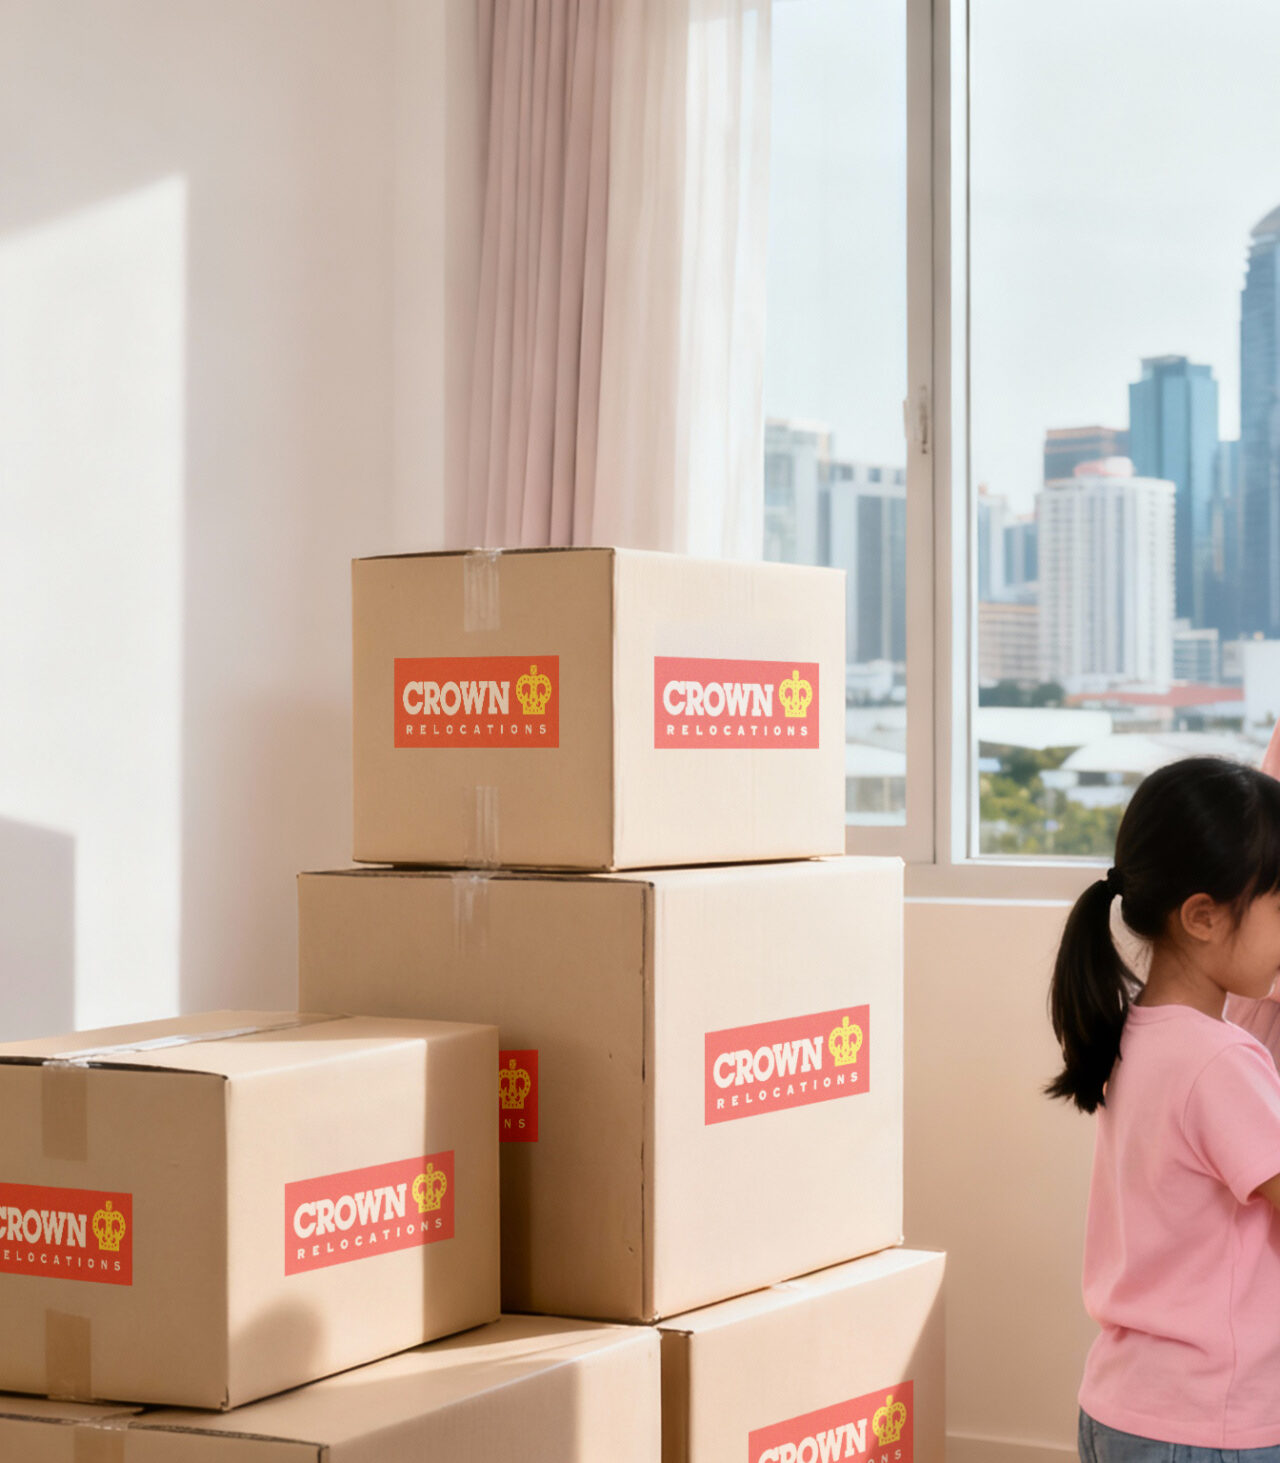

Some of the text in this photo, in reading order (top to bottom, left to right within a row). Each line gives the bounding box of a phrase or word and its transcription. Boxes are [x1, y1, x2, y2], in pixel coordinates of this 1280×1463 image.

[403, 681, 510, 716] CROWN
[663, 680, 774, 717] CROWN
[406, 724, 546, 735] RELOCATIONS
[667, 724, 808, 736] RELOCATIONS
[713, 1036, 824, 1089] CROWN
[717, 1072, 858, 1110] RELOCATIONS
[293, 1183, 407, 1239] CROWN
[297, 1218, 442, 1260] RELOCATIONS
[3, 1250, 121, 1271] ELOCATIONS
